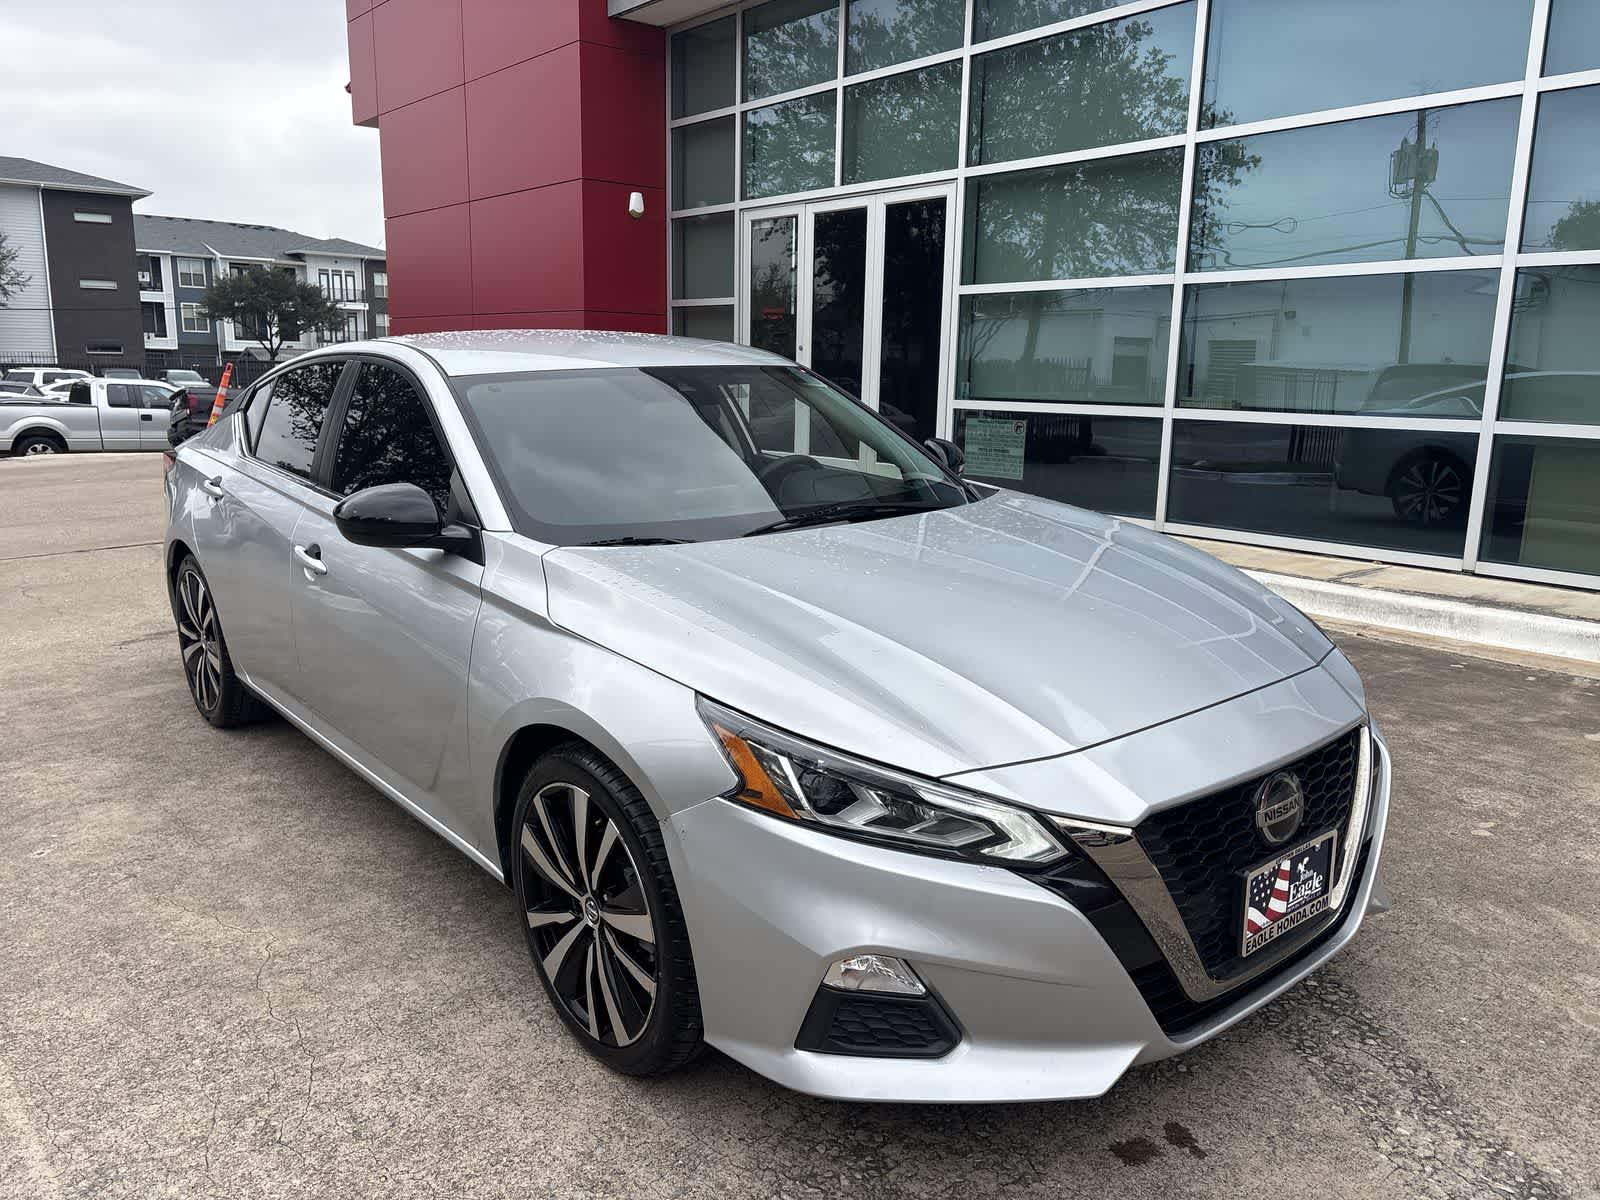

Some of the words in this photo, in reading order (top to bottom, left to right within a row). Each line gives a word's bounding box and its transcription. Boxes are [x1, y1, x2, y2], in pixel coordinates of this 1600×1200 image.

[1264, 798, 1300, 822] NISSAN
[1289, 873, 1323, 903] Eagle
[1300, 869, 1314, 882] John
[1246, 928, 1274, 953] EAGLE
[1276, 896, 1329, 933] HONDA.COM
